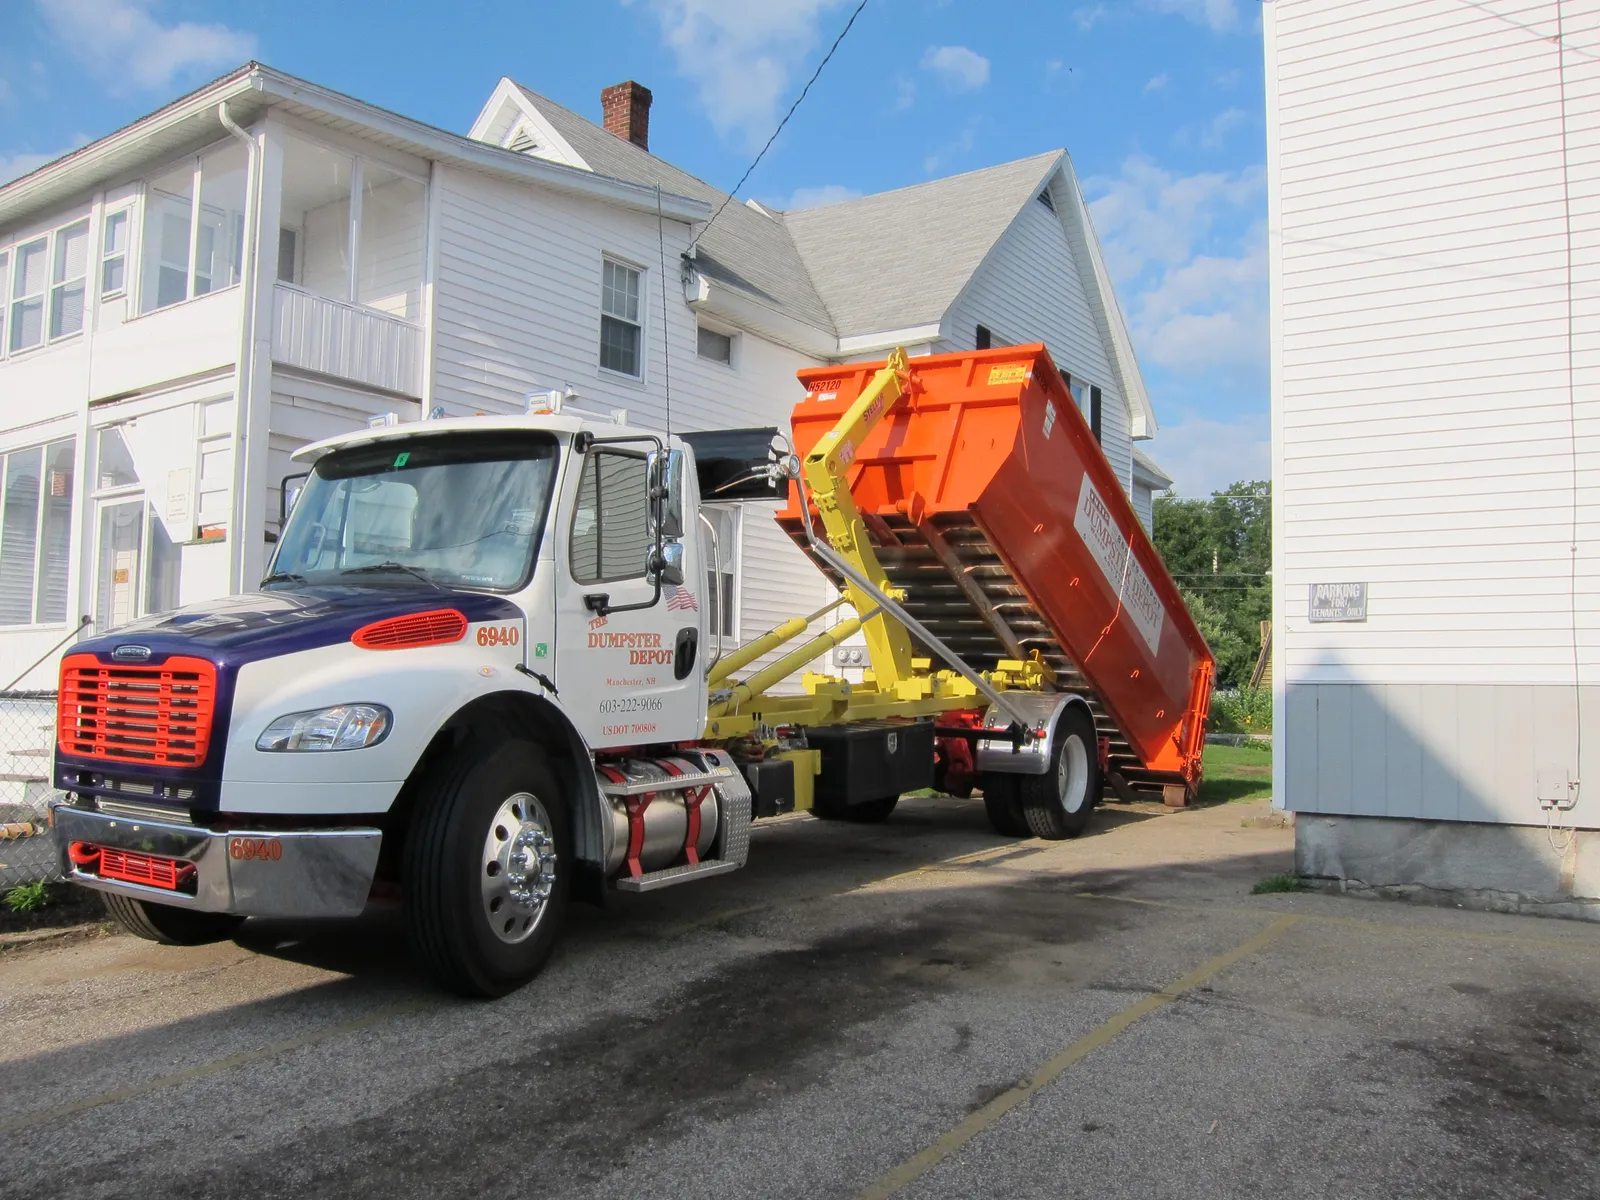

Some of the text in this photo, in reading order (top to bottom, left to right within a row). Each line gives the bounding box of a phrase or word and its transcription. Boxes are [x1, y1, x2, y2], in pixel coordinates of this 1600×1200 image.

[808, 380, 841, 392] H52120
[1317, 584, 1360, 599] PARKING
[1331, 598, 1348, 608] FOR
[1347, 608, 1363, 617] ONLY
[477, 627, 519, 646] 6940
[588, 632, 661, 648] DUMPSTER
[629, 650, 673, 665] DEPOT
[606, 677, 656, 686] Manchester, NH
[599, 697, 663, 713] 603-222-9066
[230, 838, 282, 861] 6940
